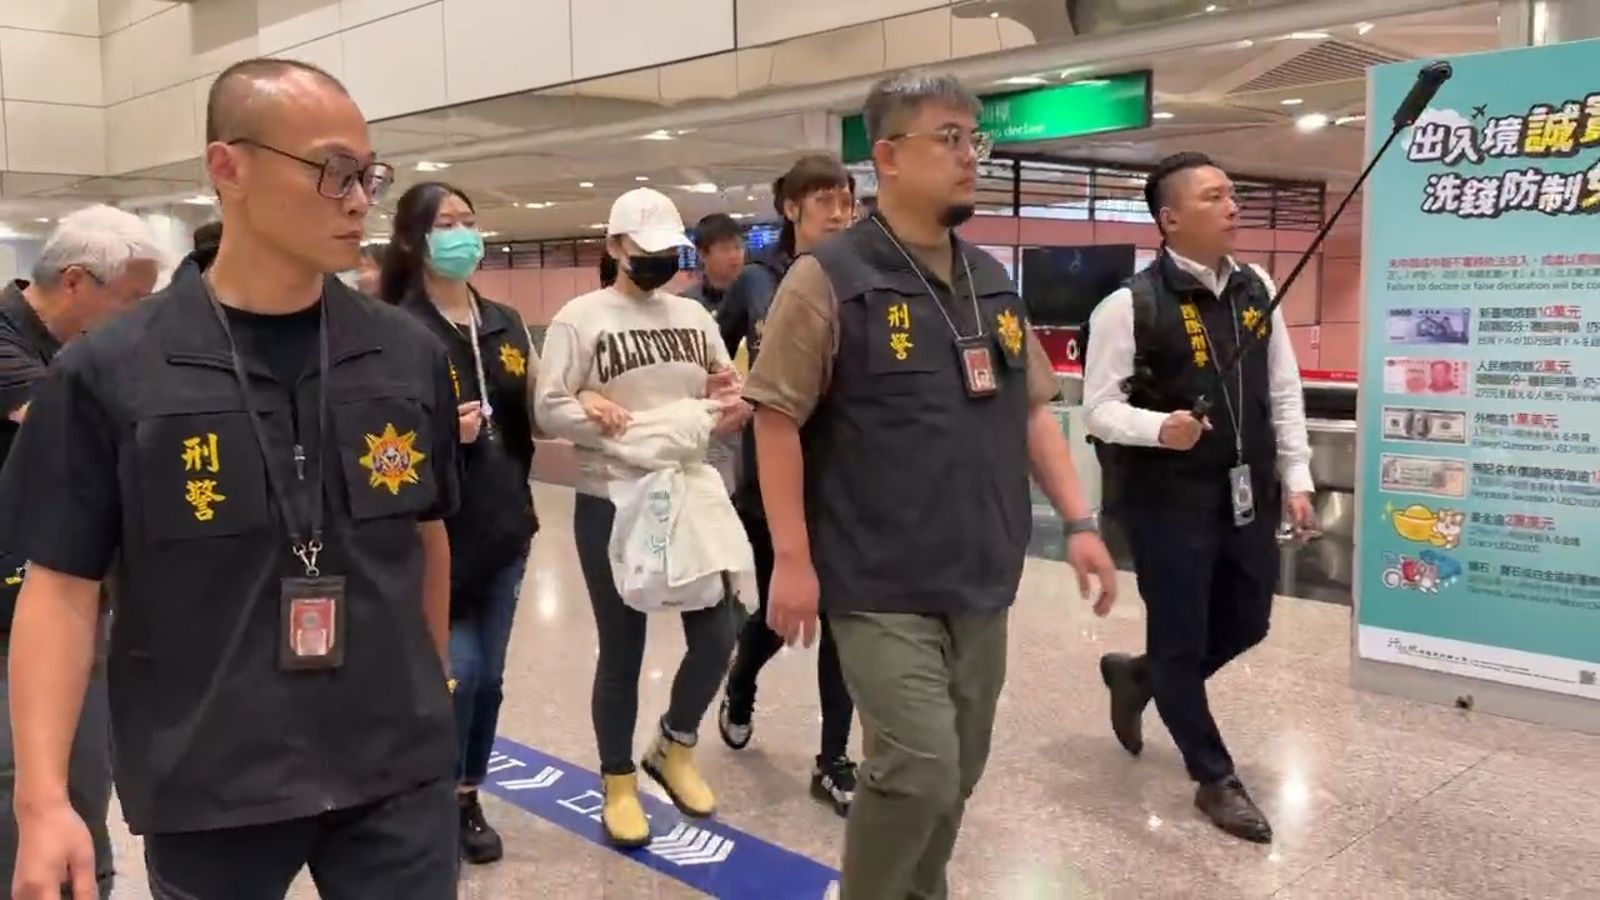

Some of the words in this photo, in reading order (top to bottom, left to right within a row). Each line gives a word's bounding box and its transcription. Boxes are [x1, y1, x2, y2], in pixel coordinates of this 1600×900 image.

[1416, 282, 1426, 290] to
[1427, 282, 1460, 291] declare
[1461, 283, 1471, 291] or
[1473, 281, 1494, 290] false
[1496, 281, 1550, 290] declaration
[1552, 281, 1569, 290] will
[1571, 280, 1584, 289] be
[887, 302, 914, 360] 刑警
[181, 432, 226, 521] 刑警
